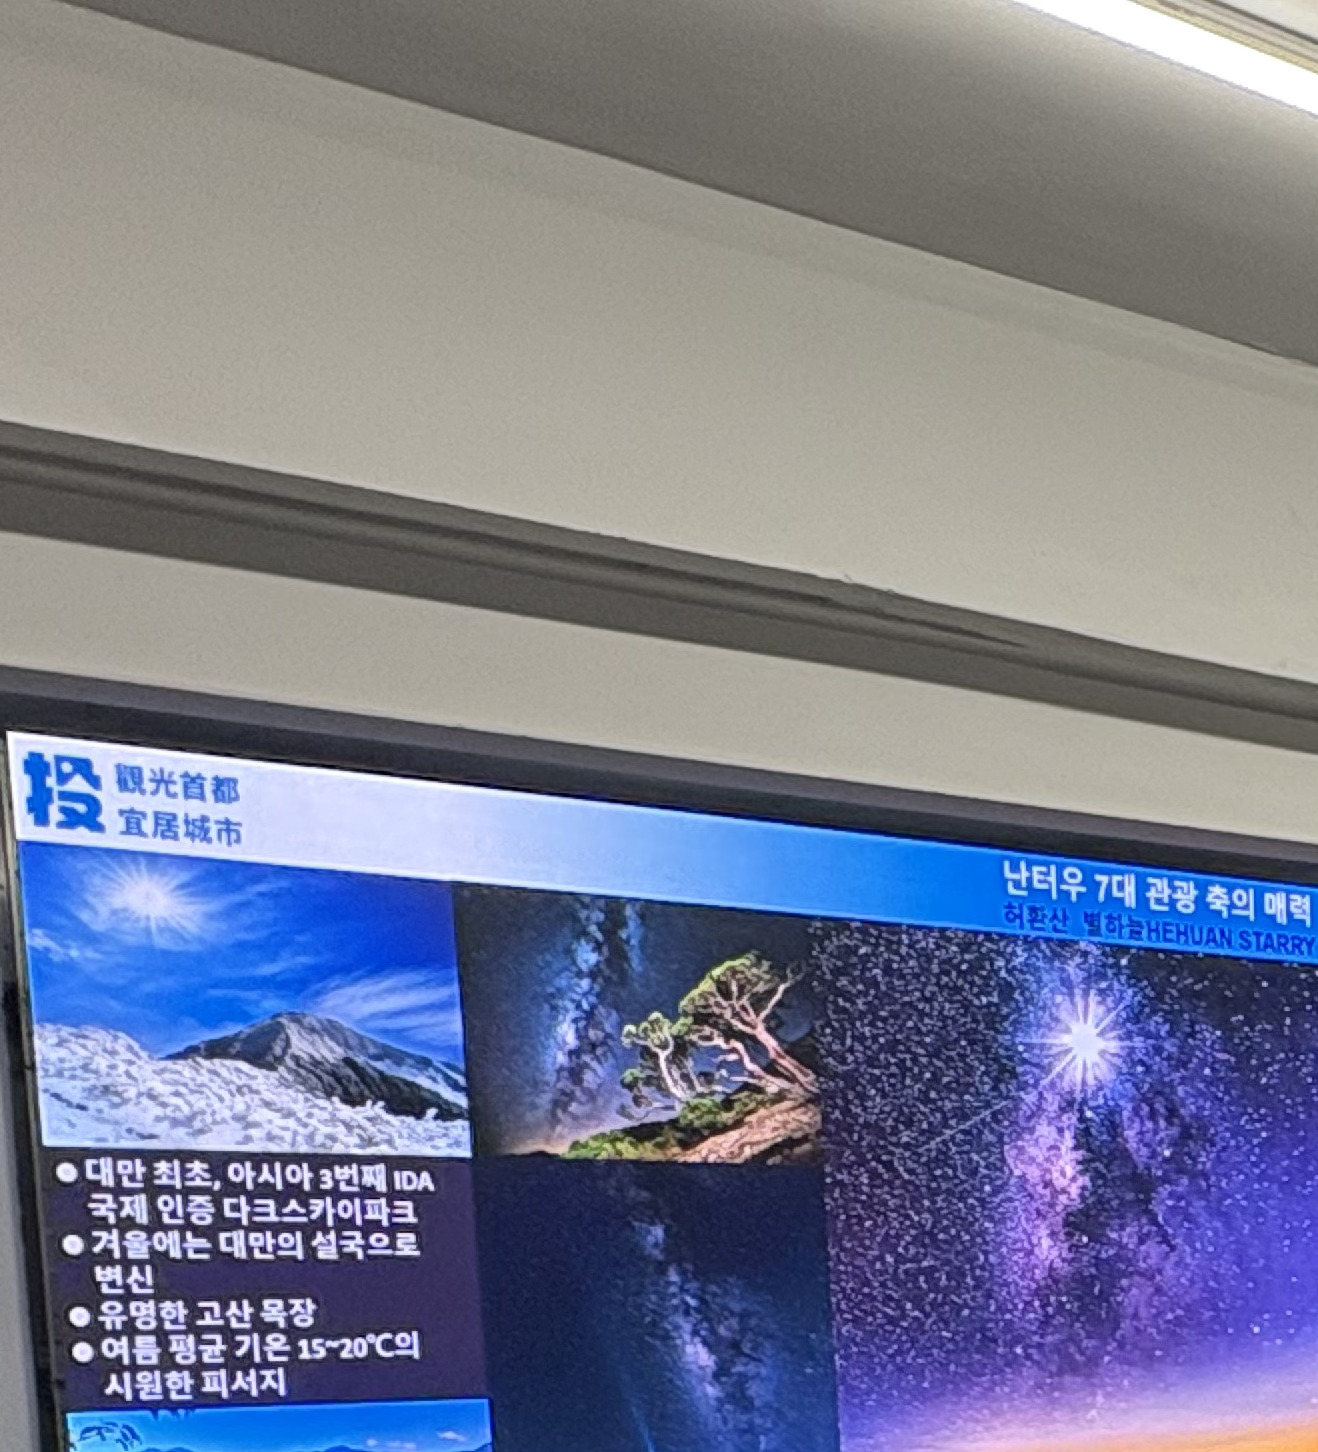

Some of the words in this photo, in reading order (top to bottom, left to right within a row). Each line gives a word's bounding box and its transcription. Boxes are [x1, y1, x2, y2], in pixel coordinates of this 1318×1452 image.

[115, 763, 240, 804] 觀光首都
[117, 807, 243, 848] 宜居城市
[1004, 860, 1087, 902] 난터우
[1094, 873, 1136, 909] 7대
[1146, 877, 1199, 914] 관광
[1206, 885, 1255, 922] 축의
[1264, 892, 1311, 928] 매력
[85, 1157, 146, 1187] 대만
[154, 1159, 220, 1191] 최초,
[228, 1161, 313, 1191] 아시아
[320, 1163, 387, 1193] 3번째
[394, 1171, 434, 1191] IDA
[88, 1193, 148, 1224] 국제
[157, 1195, 215, 1225] 인증
[224, 1197, 418, 1227] 다크스카이파크
[92, 1229, 212, 1259] 겨울에는
[219, 1230, 304, 1260] 대만의
[311, 1231, 420, 1259] 설국으로
[94, 1265, 154, 1294] 변신
[98, 1299, 188, 1330] 유명한
[196, 1299, 254, 1329] 고산
[260, 1298, 316, 1328] 목장
[102, 1335, 161, 1365] 여름
[169, 1334, 227, 1364] 평균
[235, 1333, 290, 1363] 기온
[105, 1370, 194, 1401] 시원한
[202, 1368, 286, 1399] 피서지
